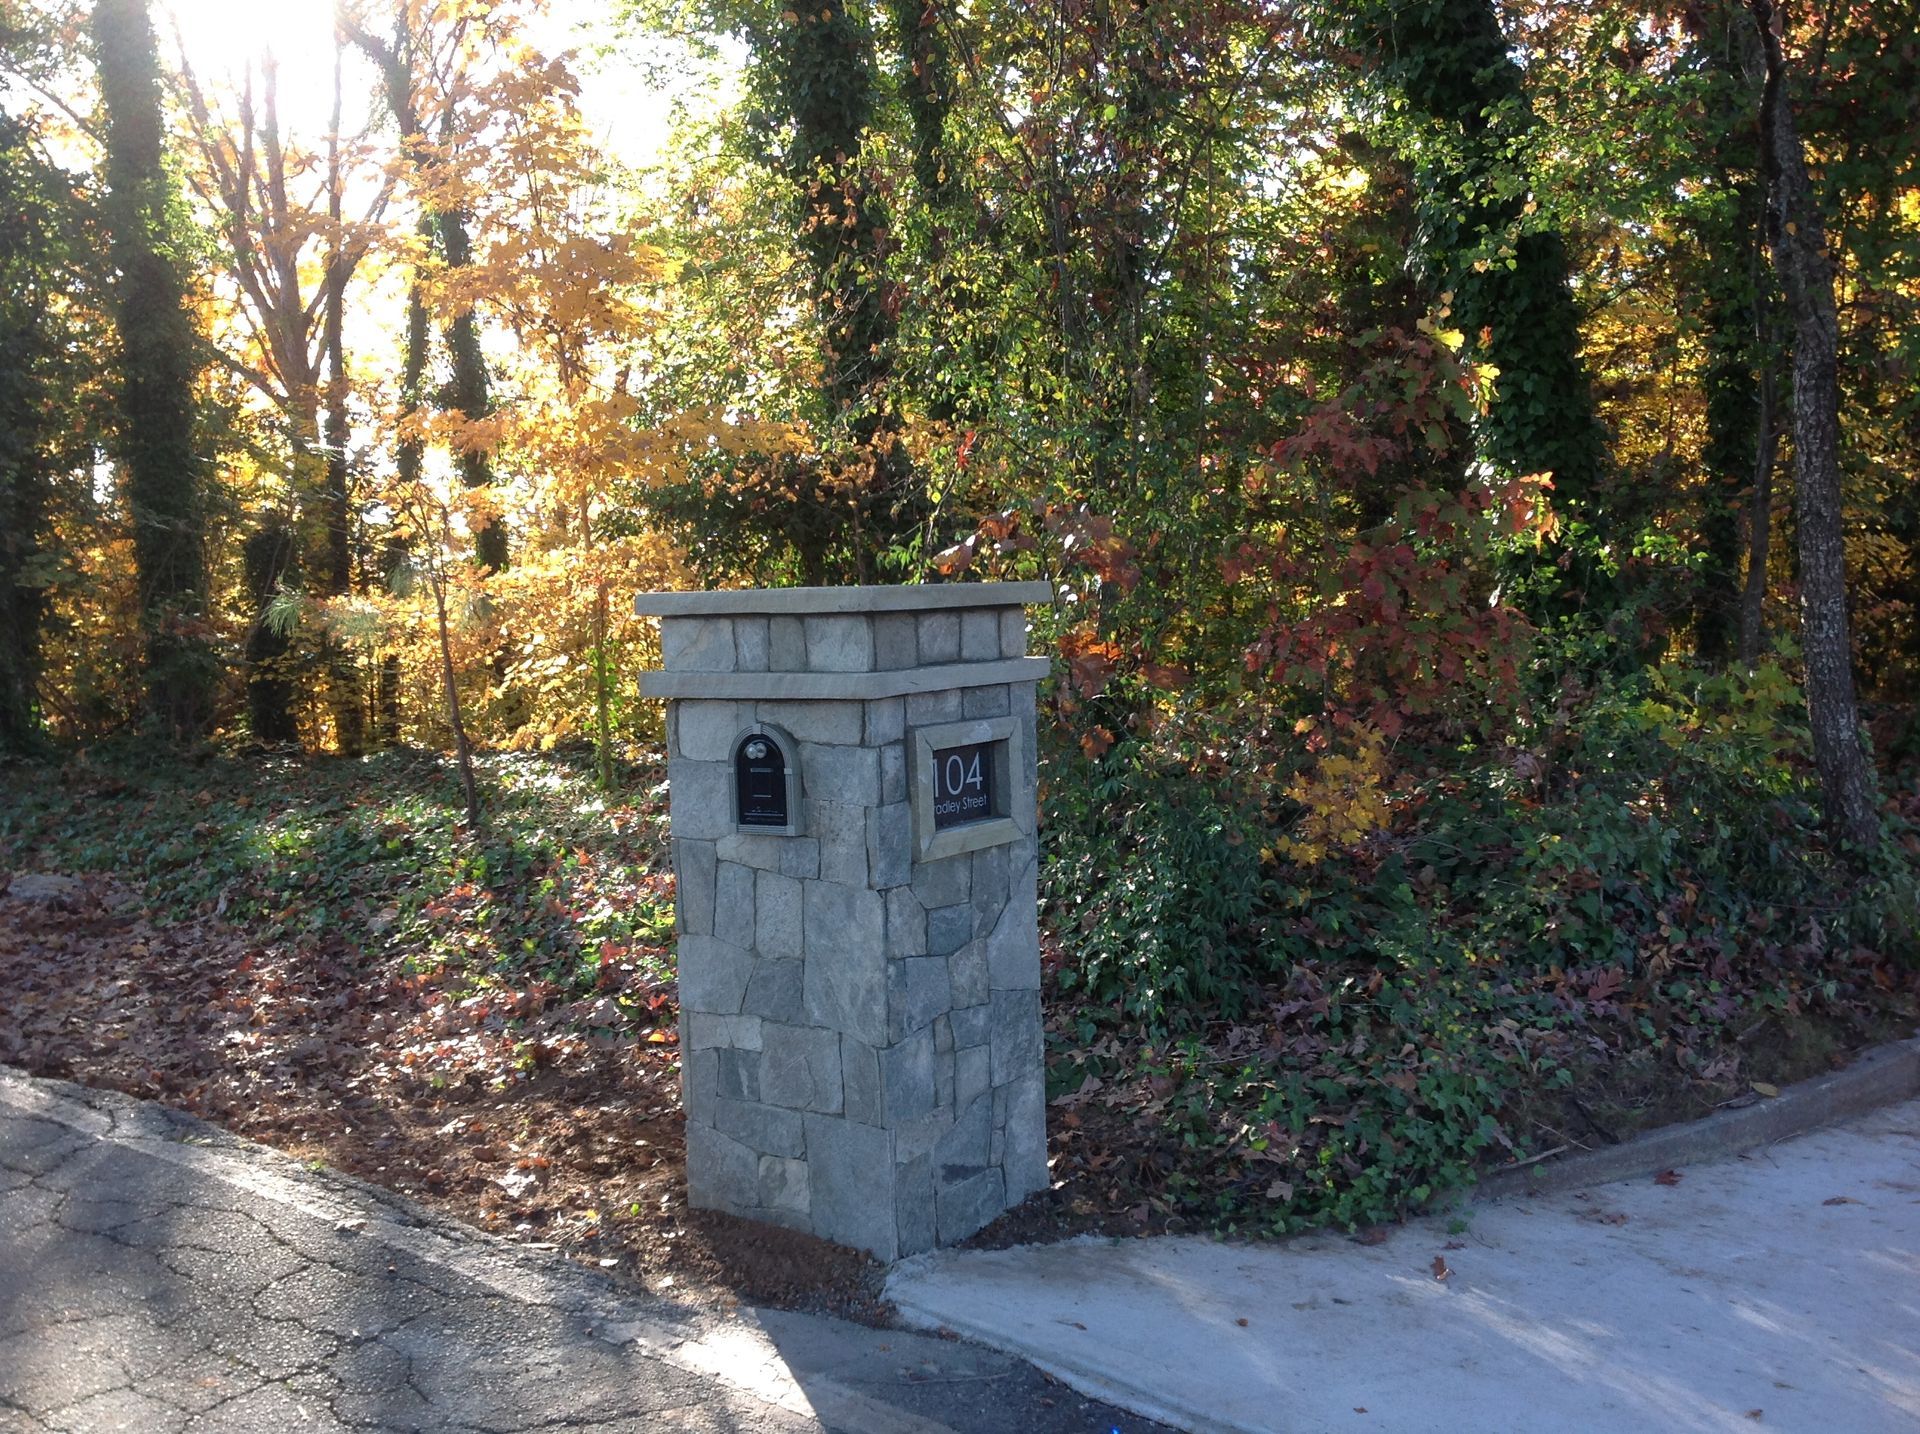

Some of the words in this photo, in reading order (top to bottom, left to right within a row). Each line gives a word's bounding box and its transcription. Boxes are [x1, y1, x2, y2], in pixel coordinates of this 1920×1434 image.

[933, 751, 983, 798] 104
[934, 800, 960, 815] adley
[962, 794, 987, 810] Street
